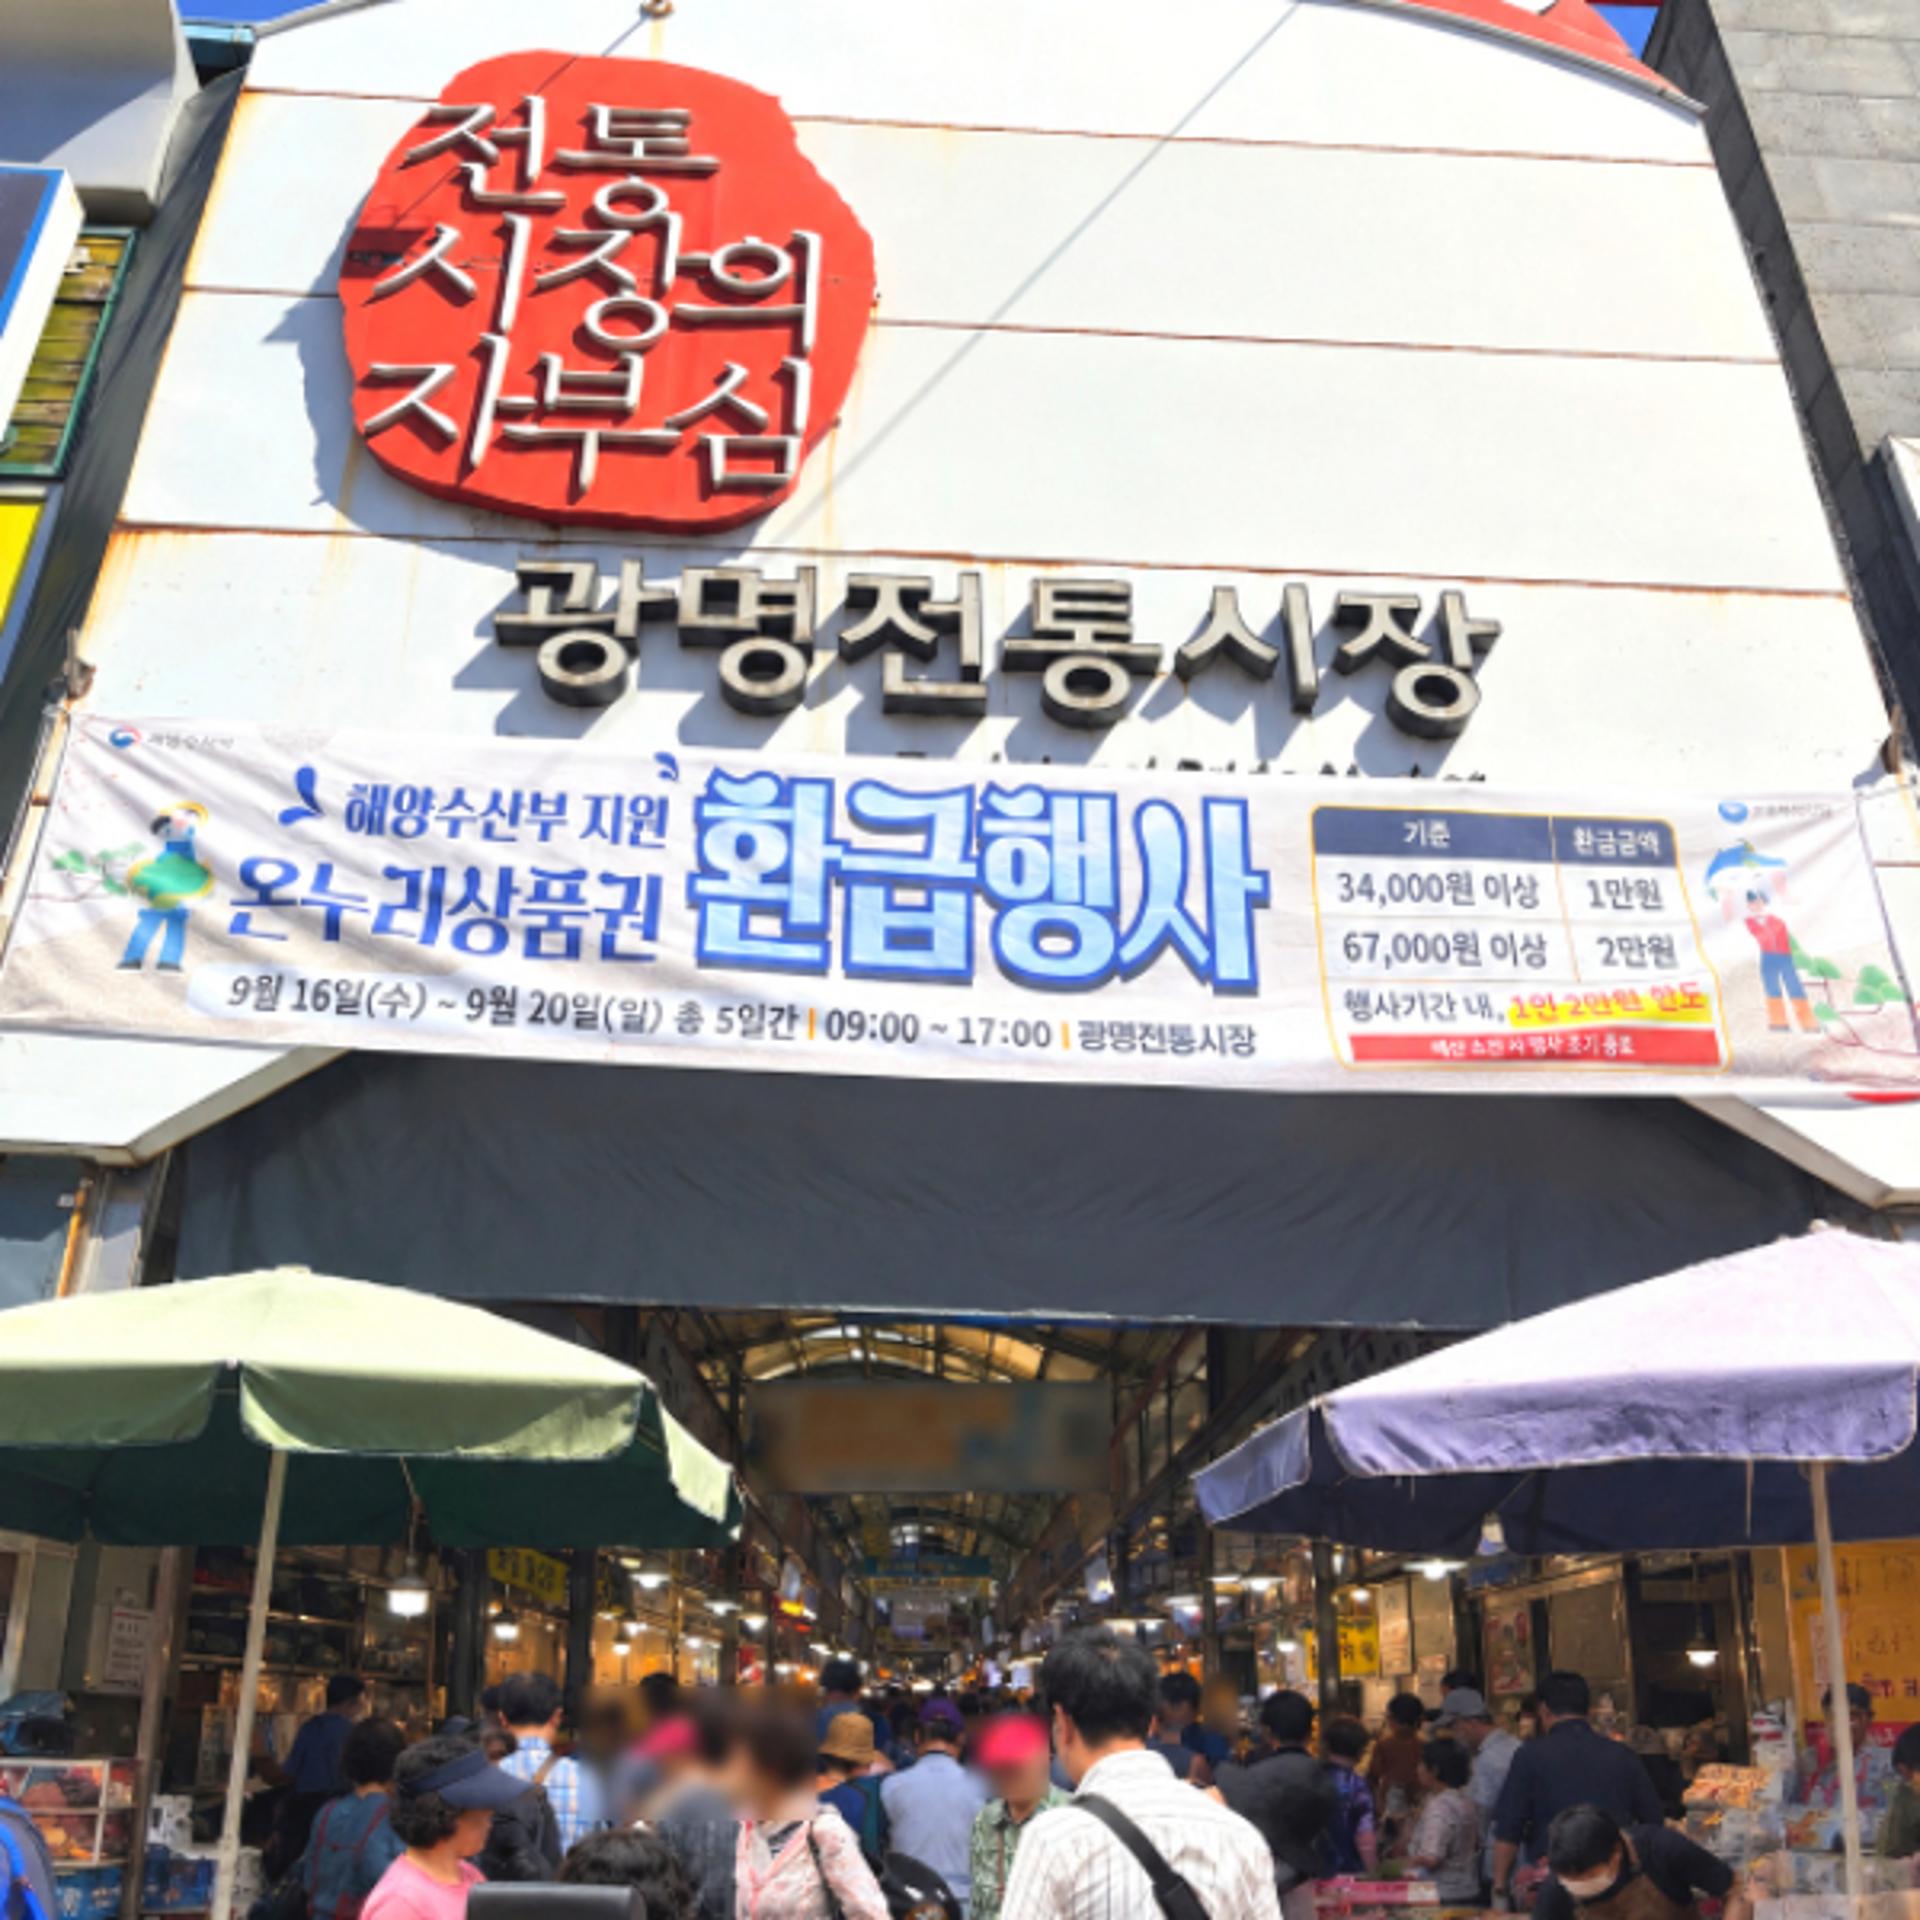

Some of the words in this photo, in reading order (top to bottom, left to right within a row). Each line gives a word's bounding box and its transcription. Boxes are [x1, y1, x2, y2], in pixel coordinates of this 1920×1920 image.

[404, 96, 719, 227] 전통
[372, 212, 821, 353] 시장의
[364, 334, 811, 492] 자부심
[495, 558, 1501, 738] 광명전통시장
[345, 782, 569, 841] 해양수산부
[580, 794, 669, 848] 지원
[1402, 820, 1451, 848] 기준
[1572, 827, 1660, 857] 환급금액
[229, 856, 660, 961] 온누리상품권
[686, 765, 1270, 995] 환급행사
[1337, 871, 1476, 908] 34,000원
[1484, 873, 1540, 910] 이상
[1588, 877, 1665, 911] 1만원
[1343, 931, 1483, 970] 67,000원
[1490, 931, 1549, 970] 이상
[1597, 934, 1680, 971] 2만원
[228, 975, 284, 1013] 9월
[294, 977, 427, 1020] 16일(수)
[465, 987, 518, 1026] 9월
[528, 989, 664, 1036] 20일(일)
[676, 1001, 704, 1037] 총
[715, 1005, 801, 1041] 5일간
[825, 1009, 919, 1045] 09:00
[961, 1015, 1052, 1048] 17:00
[1078, 1020, 1256, 1057] 광명전통시장
[1343, 989, 1457, 1023] 행사기간
